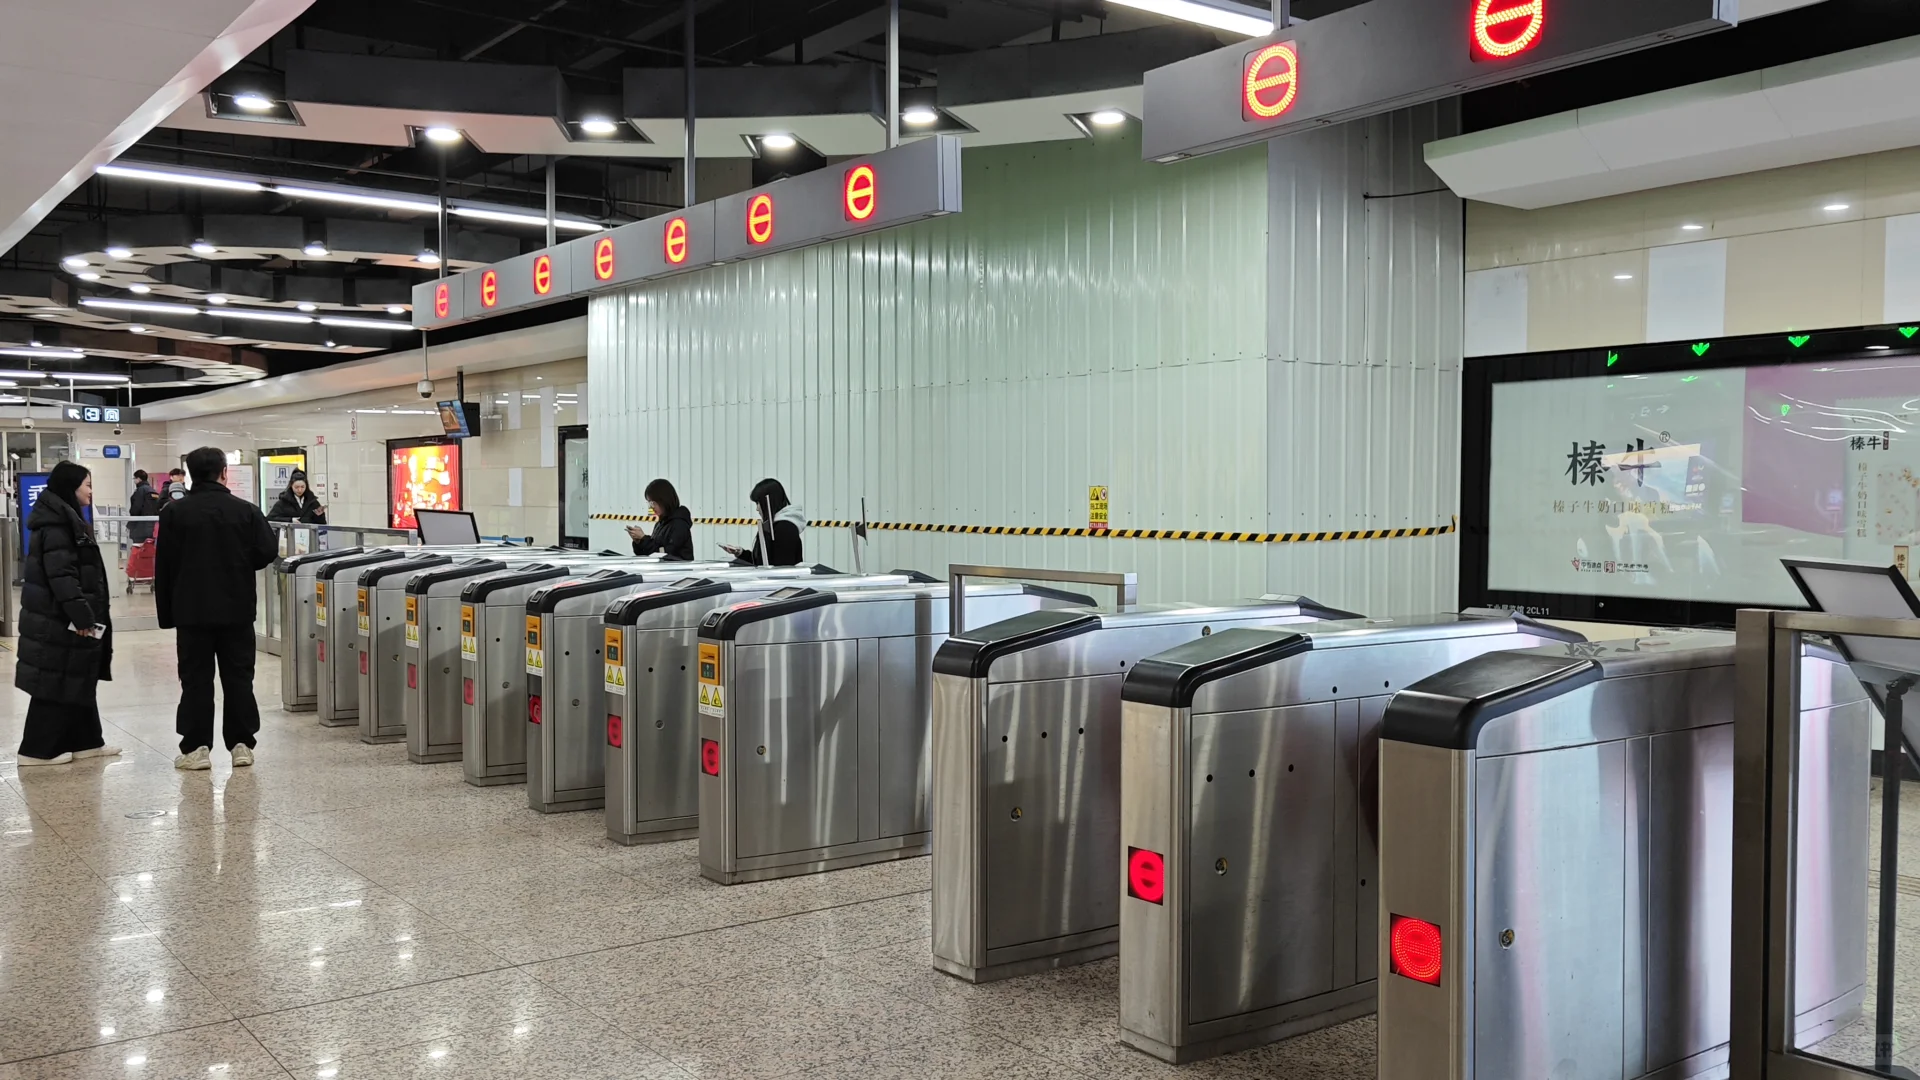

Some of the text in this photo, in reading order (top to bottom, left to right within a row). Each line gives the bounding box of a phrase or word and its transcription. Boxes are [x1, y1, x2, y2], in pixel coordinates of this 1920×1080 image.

[1850, 436, 1881, 451] 榛牛
[1564, 438, 1662, 488] 榛牛
[1526, 606, 1550, 616] 2CL11
